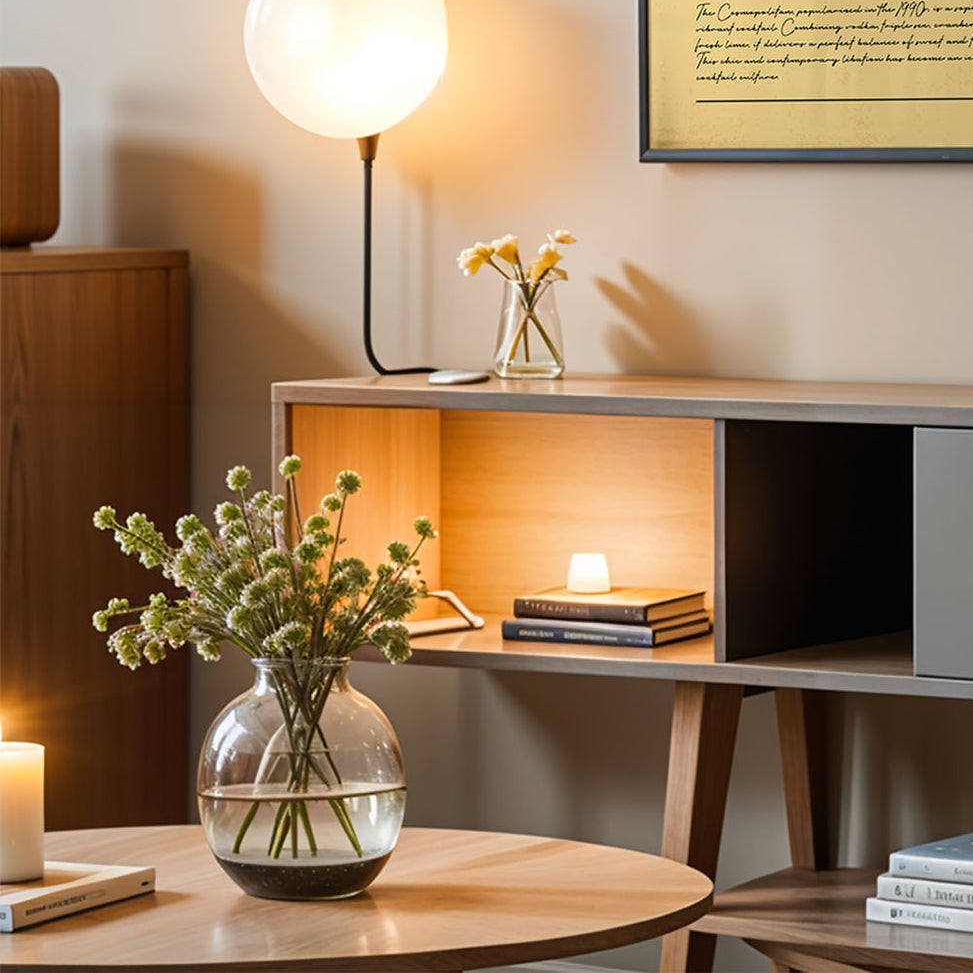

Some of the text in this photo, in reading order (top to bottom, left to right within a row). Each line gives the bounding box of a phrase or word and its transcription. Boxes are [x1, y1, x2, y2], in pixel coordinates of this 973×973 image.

[696, 2, 716, 21] The
[717, 3, 795, 22] Cosmopolitan,
[795, 5, 863, 18] popularized
[876, 2, 896, 17] the
[696, 22, 736, 35] vibrant
[781, 17, 842, 37] Combining
[879, 19, 913, 33] triple
[694, 37, 723, 53] fresh
[753, 37, 762, 51] it
[763, 39, 806, 48] delivers
[817, 35, 856, 50] perfect
[857, 37, 900, 47] balance
[902, 34, 914, 49] of
[915, 35, 945, 48] sweet
[946, 36, 968, 45] and
[696, 50, 718, 69] This
[720, 56, 742, 64] chic
[744, 55, 765, 64] and
[766, 53, 840, 67] contemporary
[842, 52, 884, 66] libation
[885, 54, 905, 63] has
[907, 54, 945, 62] become
[696, 70, 737, 84] cocktail
